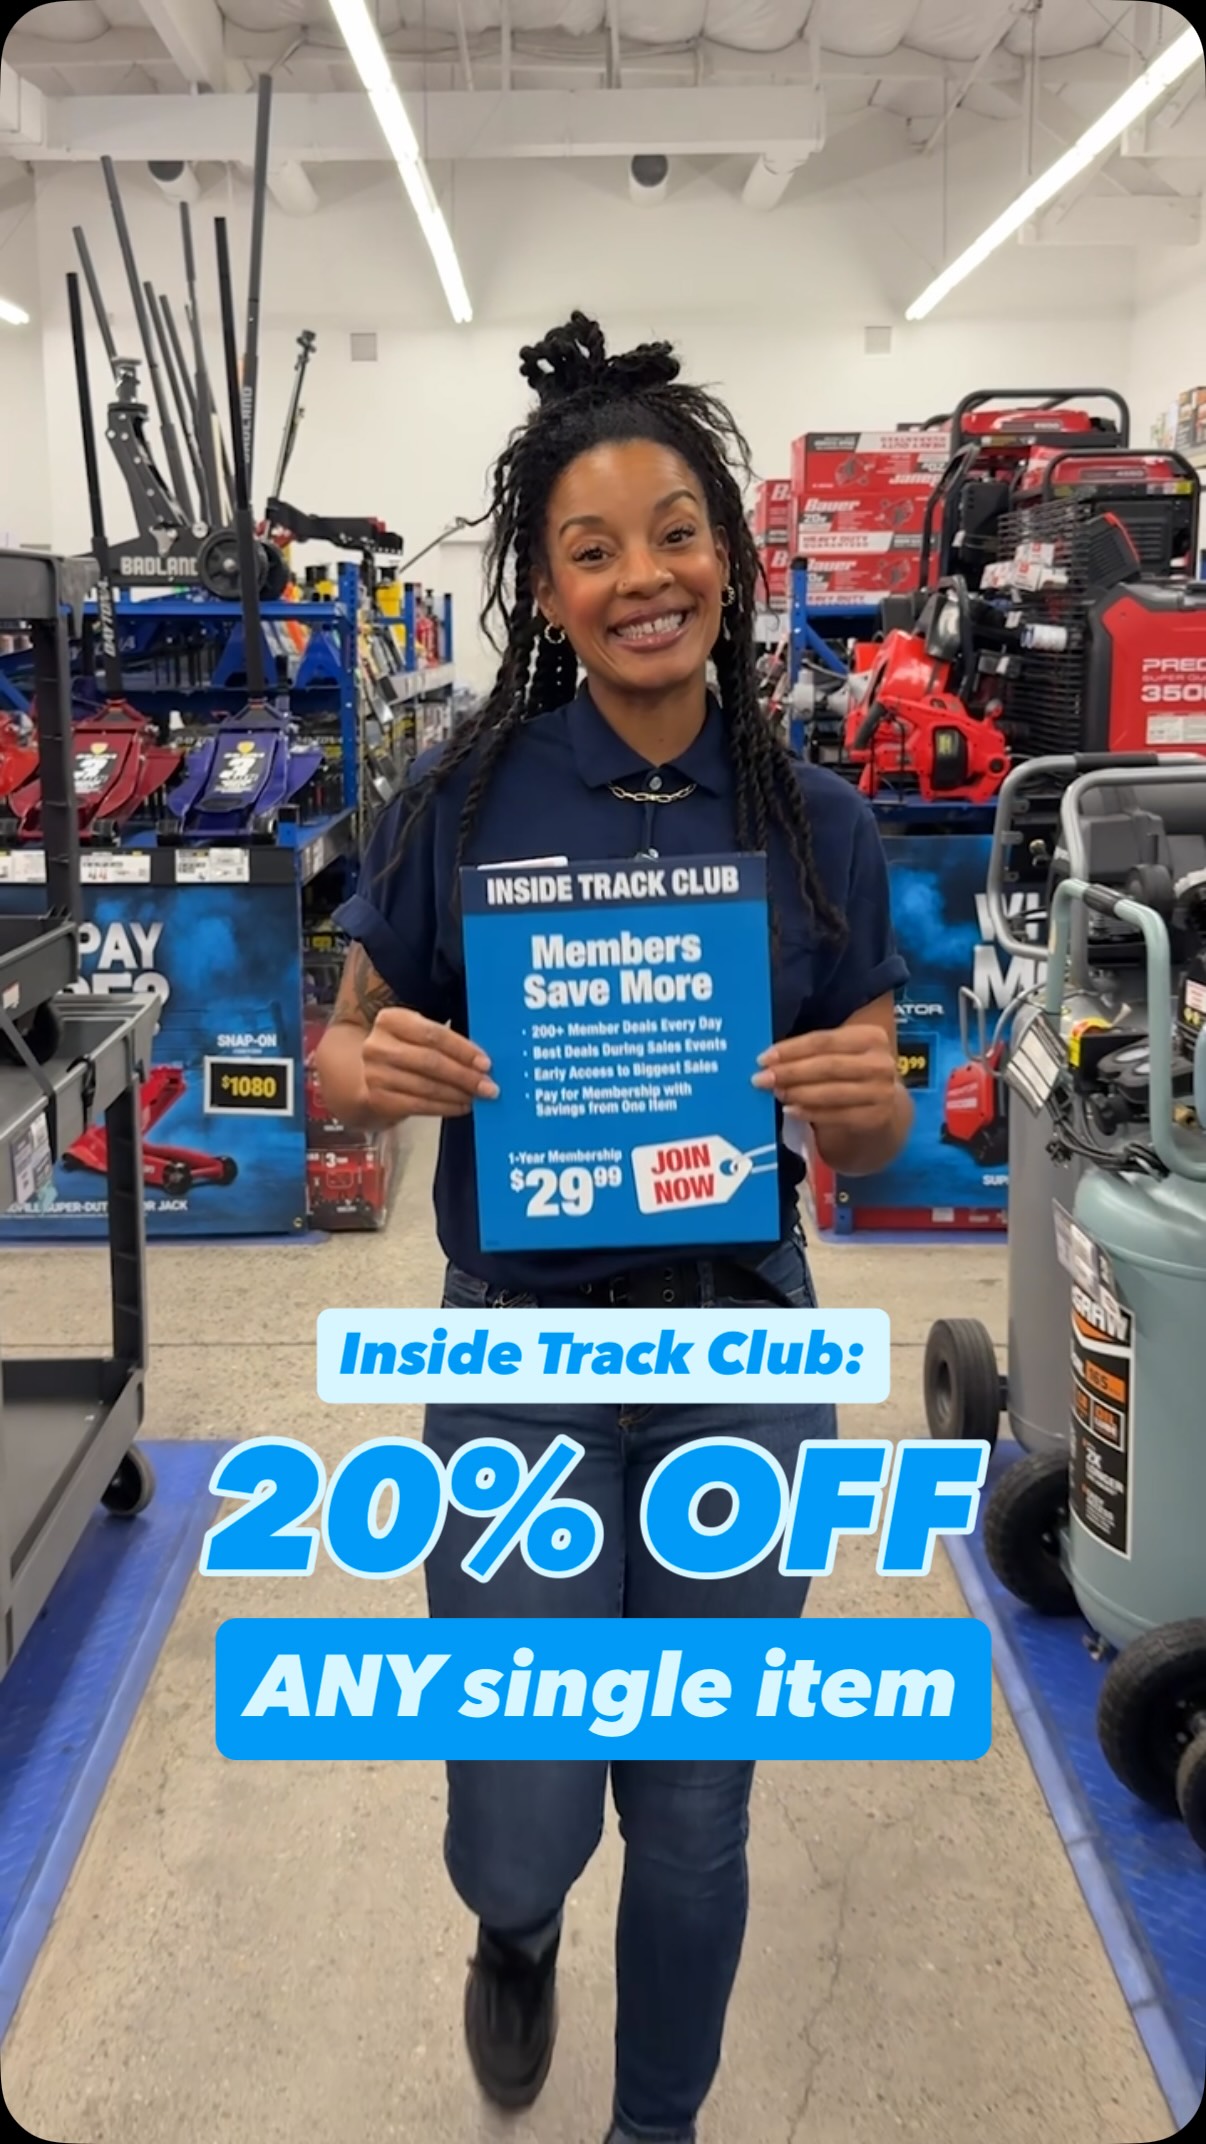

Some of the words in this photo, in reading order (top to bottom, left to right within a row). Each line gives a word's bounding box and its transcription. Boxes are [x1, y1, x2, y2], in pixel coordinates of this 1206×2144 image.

[805, 499, 860, 512] Bauer
[1141, 684, 1206, 702] 350
[487, 875, 572, 905] INSIDE
[577, 870, 667, 902] TRACK
[672, 866, 739, 896] CLUB
[531, 931, 702, 970] Members
[523, 974, 610, 1009] Save
[620, 969, 713, 1004] More
[531, 1023, 565, 1039] 200+
[567, 1020, 619, 1036] Member
[622, 1018, 658, 1034] Deals
[660, 1017, 696, 1034] Every
[698, 1015, 723, 1033] Day
[217, 1034, 277, 1047] SNAP-ON
[533, 1045, 562, 1060] Best
[564, 1042, 599, 1058] Deals
[602, 1042, 645, 1057] During
[647, 1039, 682, 1054] Sales
[684, 1037, 727, 1052] Events
[533, 1066, 566, 1082] Early
[568, 1065, 614, 1079] Access
[616, 1063, 630, 1077] to
[632, 1061, 681, 1078] Biggest
[683, 1058, 719, 1074] Sales
[221, 1074, 276, 1098] $1080
[535, 1087, 558, 1104] Pay
[560, 1087, 578, 1101] for
[582, 1083, 661, 1101] Membership
[663, 1081, 692, 1096] with
[536, 1102, 586, 1118] Savings
[588, 1101, 619, 1115] from
[621, 1099, 646, 1113] One
[648, 1097, 677, 1112] Item
[508, 1151, 545, 1165] 1-Year
[547, 1148, 622, 1164] Membership
[651, 1144, 711, 1175] JOIN
[653, 1174, 715, 1204] NOW
[158, 1200, 188, 1211] JACK
